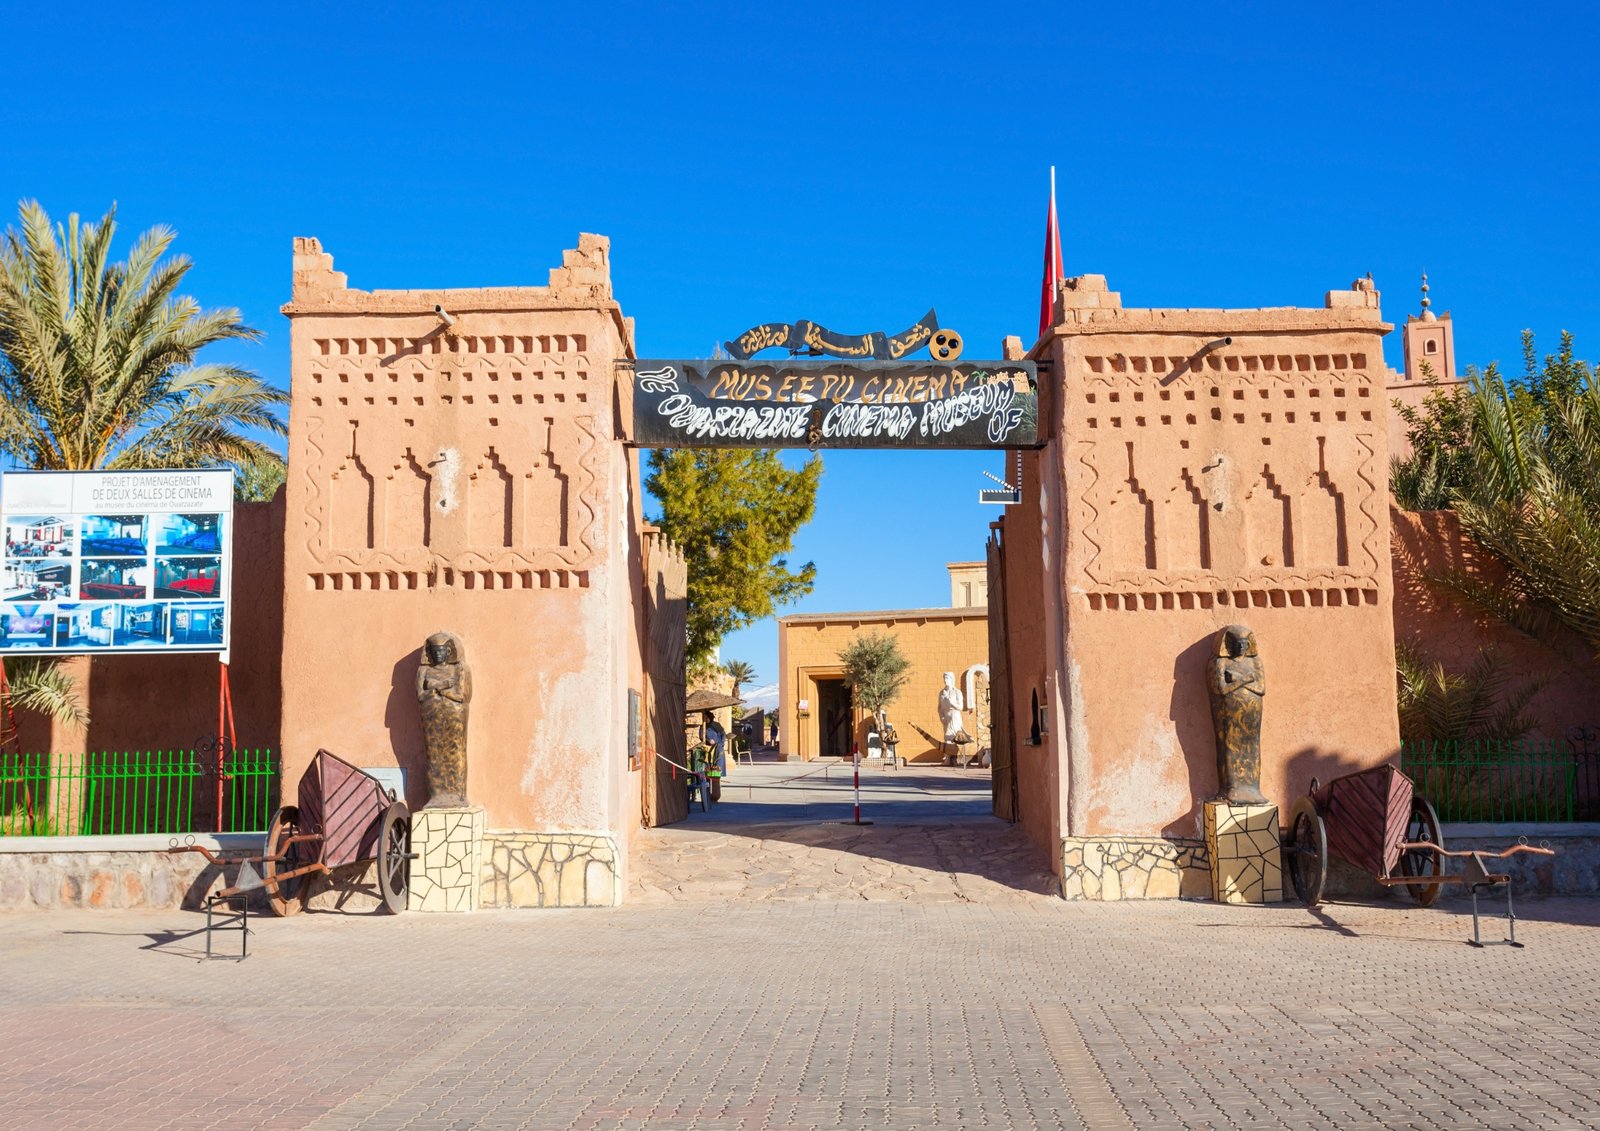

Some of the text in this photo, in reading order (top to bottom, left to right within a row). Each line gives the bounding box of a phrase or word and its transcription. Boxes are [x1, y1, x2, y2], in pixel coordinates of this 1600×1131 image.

[890, 324, 931, 359] متحف
[709, 368, 970, 404] MUSEE DU CINEMA
[822, 402, 917, 440] CINEMA
[919, 379, 1015, 437] MUSEUM
[987, 408, 1024, 443] OF
[92, 487, 212, 500] DE DEUX SALLES DE CINEMA
[102, 476, 131, 487] PROJET
